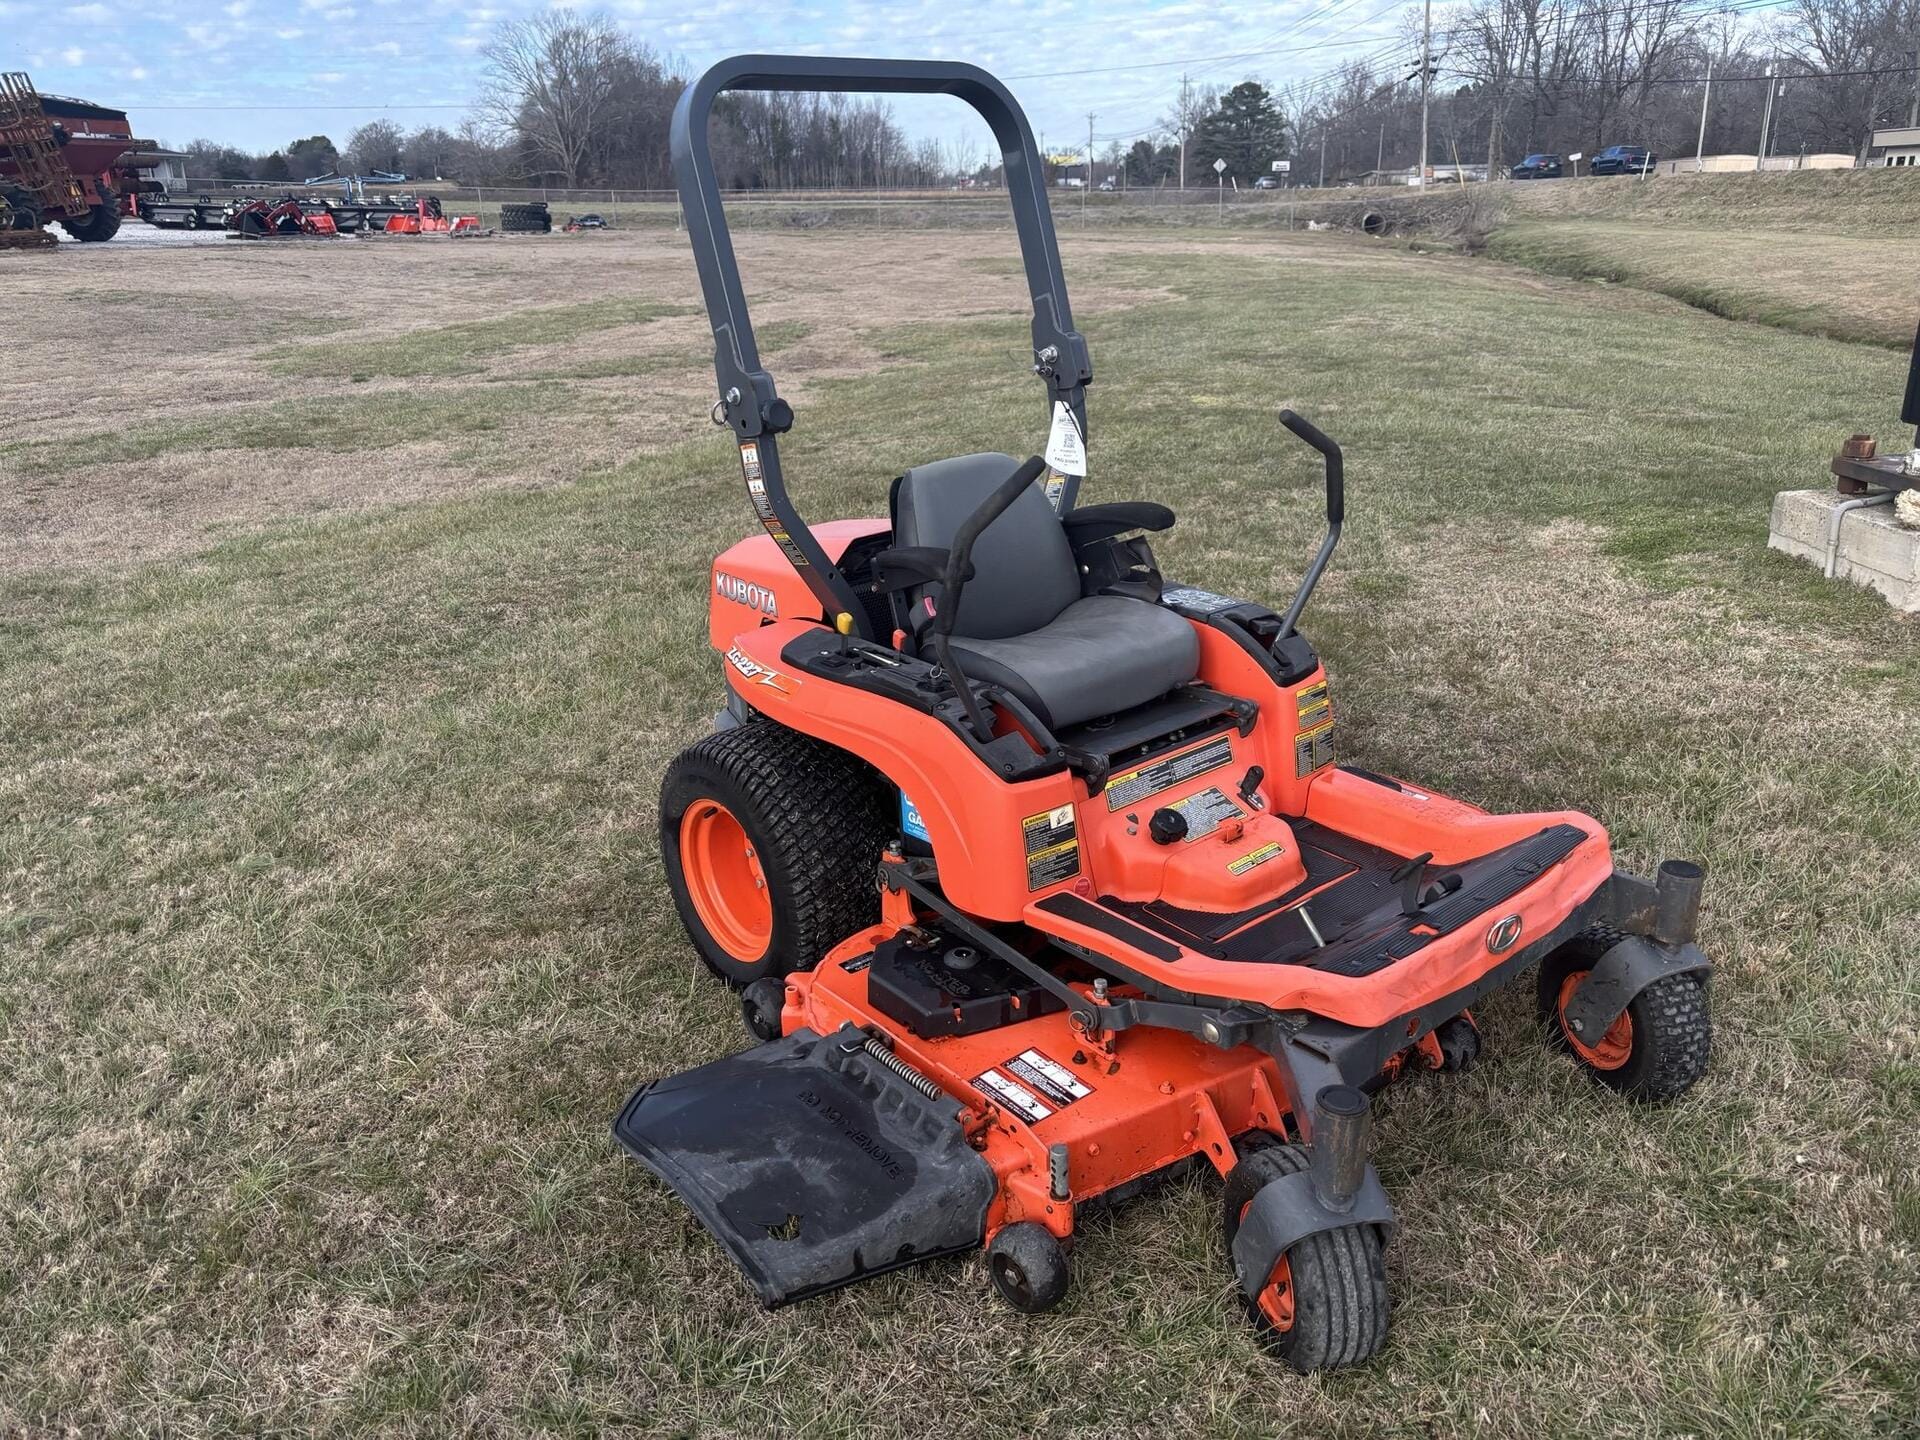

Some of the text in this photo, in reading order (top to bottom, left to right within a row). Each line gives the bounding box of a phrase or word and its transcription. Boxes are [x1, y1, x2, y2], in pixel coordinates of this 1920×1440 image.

[715, 570, 778, 617] KUBOTA
[726, 645, 764, 679] ZG227
[1029, 813, 1049, 824] WARNING
[844, 1128, 904, 1181] REMOVE
